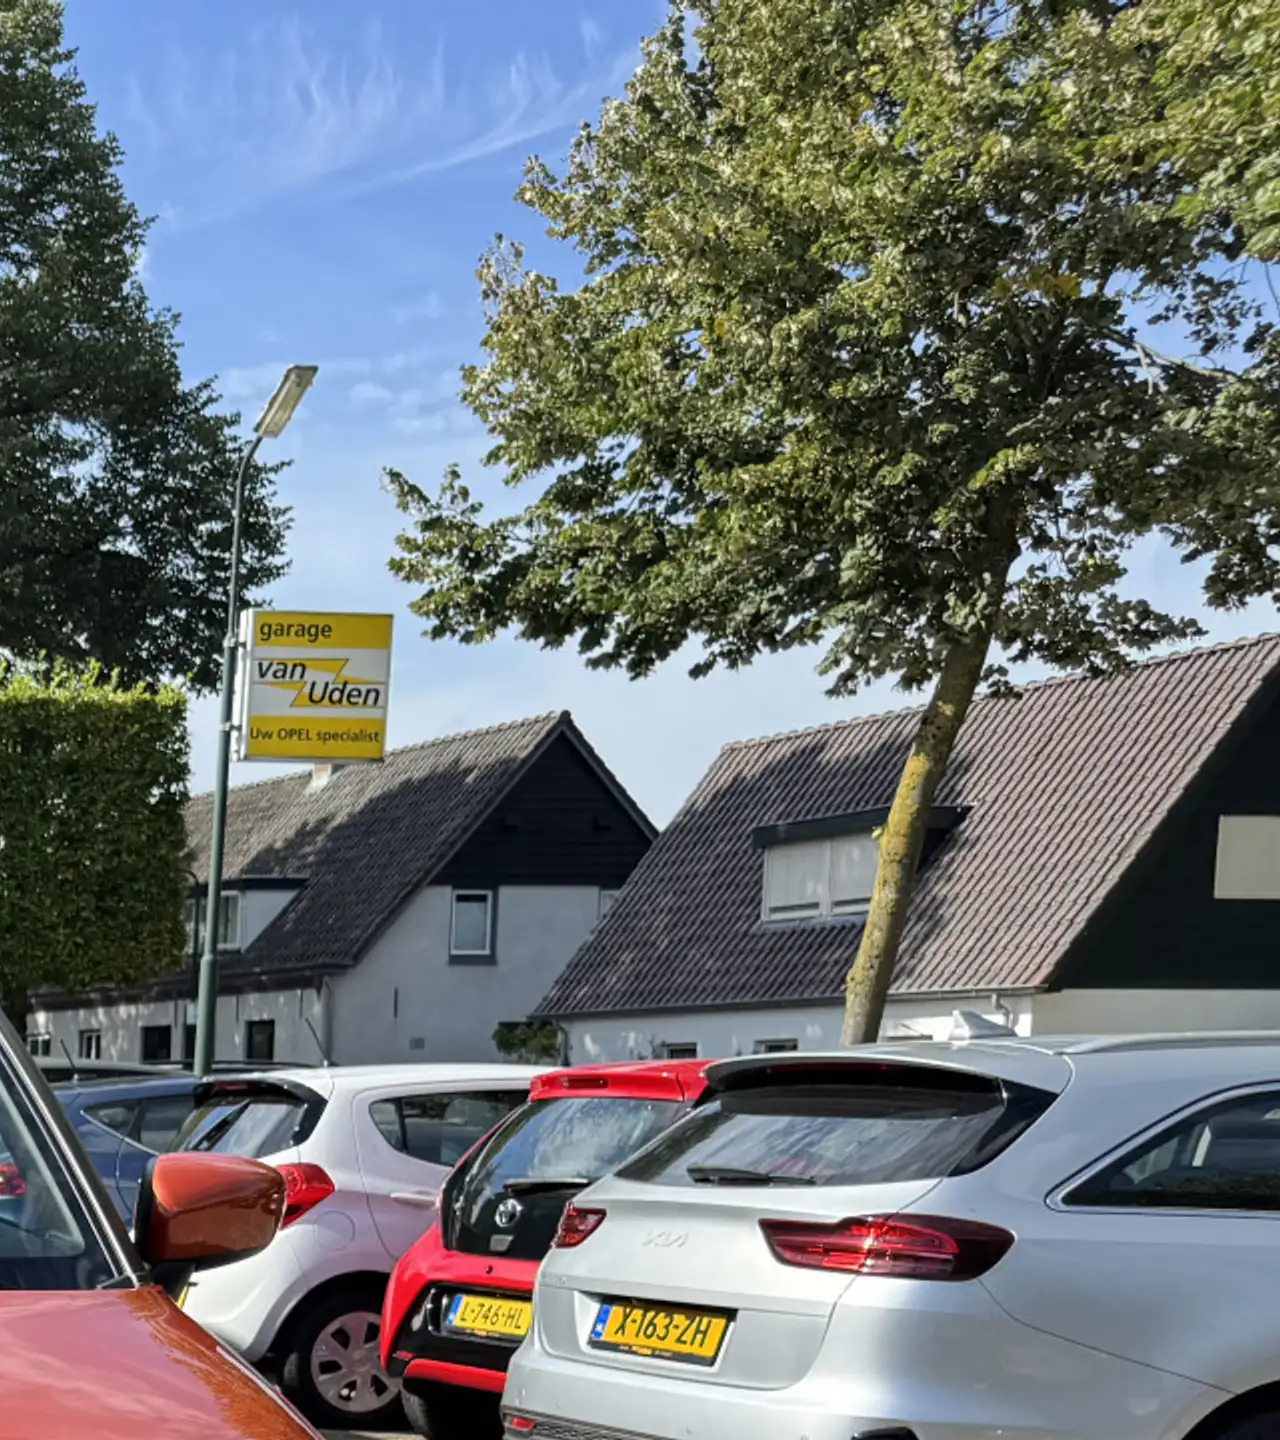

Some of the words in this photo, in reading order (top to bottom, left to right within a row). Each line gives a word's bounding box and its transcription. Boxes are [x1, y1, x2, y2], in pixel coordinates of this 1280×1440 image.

[260, 622, 333, 642] garage
[258, 661, 306, 680] van
[308, 681, 380, 706] Uden
[250, 727, 274, 740] Uw
[278, 728, 313, 741] OPEL
[316, 728, 380, 744] specialist
[460, 1301, 523, 1329] L-746-HL
[614, 1306, 712, 1348] X-163-ZH
